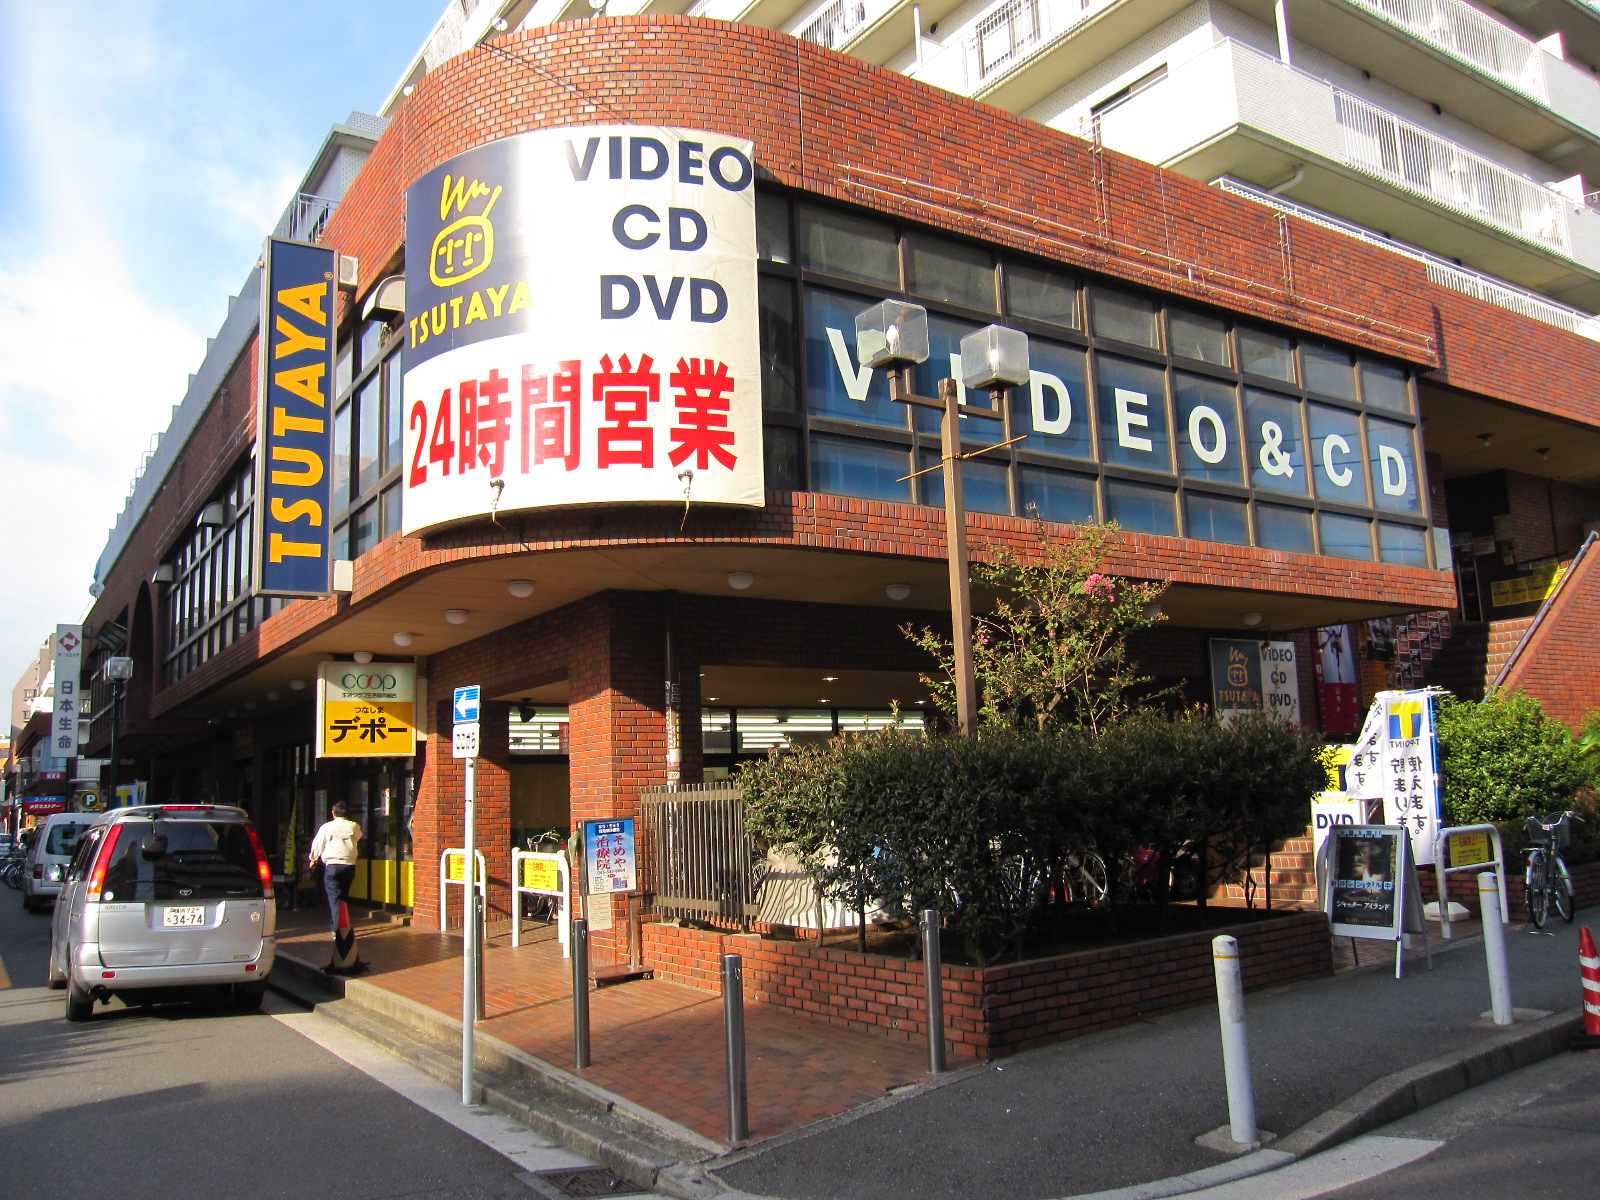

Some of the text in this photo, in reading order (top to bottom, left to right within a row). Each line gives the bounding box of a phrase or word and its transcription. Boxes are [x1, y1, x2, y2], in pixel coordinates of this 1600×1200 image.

[564, 136, 752, 192] VIDEO
[612, 204, 708, 252] CD
[600, 274, 728, 323] DVD
[409, 281, 534, 349] TSUTAYA
[269, 281, 329, 564] TSUTAYA
[409, 353, 738, 489] 24時間営業
[1322, 433, 1408, 497] CD
[1261, 648, 1293, 662] VIDEO
[1270, 671, 1287, 684] CD
[354, 706, 385, 714] つなしま
[1219, 689, 1260, 702] TSUTAA
[1269, 693, 1291, 707] DVD
[58, 680, 74, 749] 日本生命
[329, 715, 408, 744] デポー
[455, 731, 477, 751] ここから
[86, 794, 96, 806] P
[1316, 813, 1354, 829] DVD
[596, 836, 611, 870] 治療院
[613, 834, 626, 868] そめや
[173, 914, 202, 925] 34-74
[1364, 902, 1390, 910] アイランド
